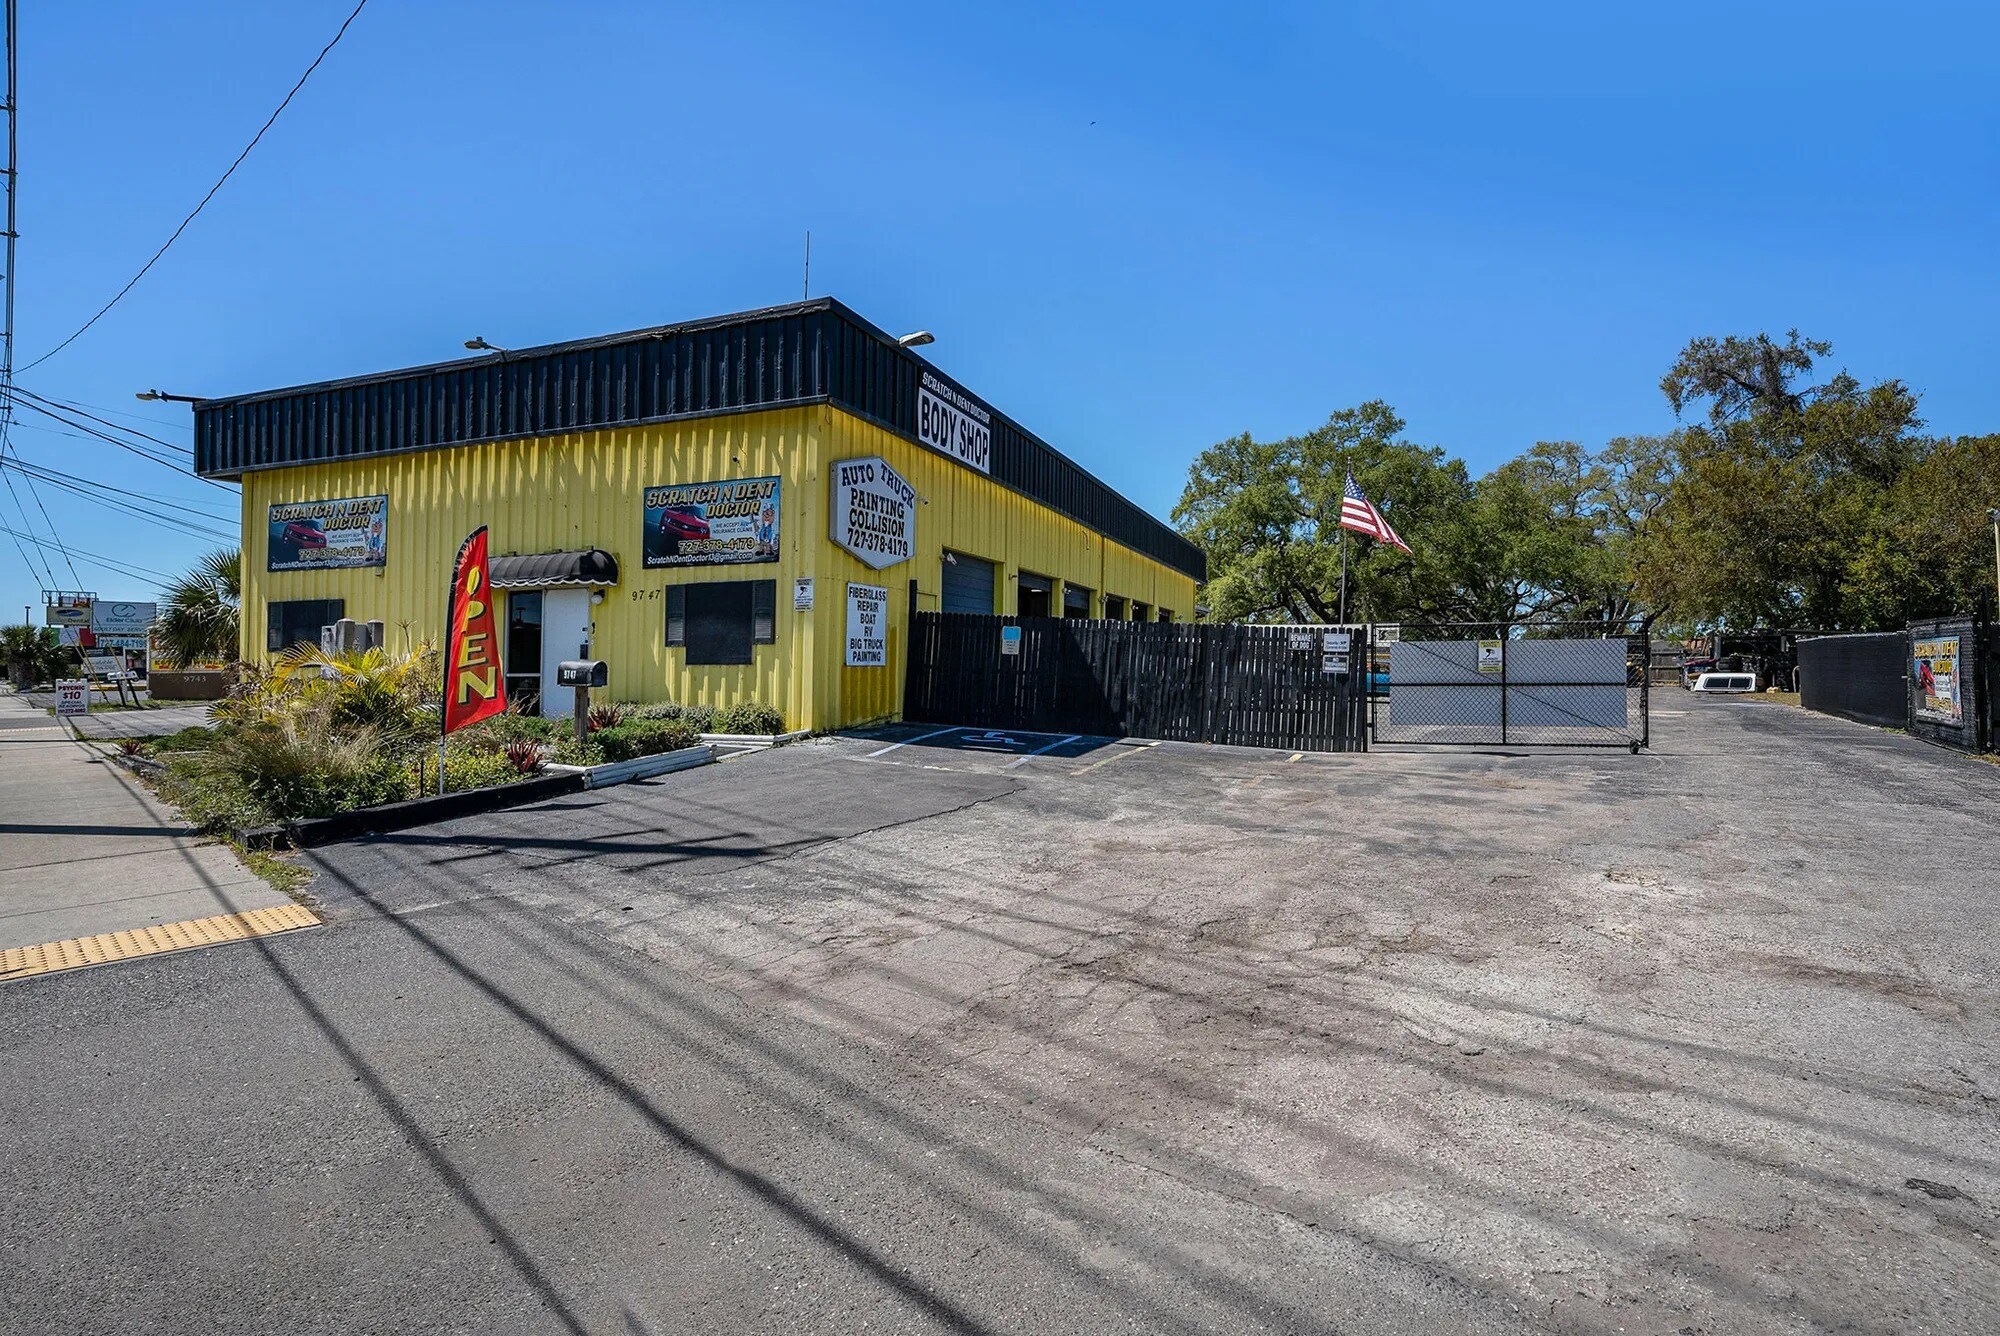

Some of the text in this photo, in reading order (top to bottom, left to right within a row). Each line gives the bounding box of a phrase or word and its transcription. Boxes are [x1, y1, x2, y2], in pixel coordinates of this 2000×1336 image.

[922, 372, 990, 424] SCRATCH N DENT DOCTOR
[921, 394, 989, 468] BODY SHOP
[841, 463, 914, 509] AUTO TRUCK
[646, 481, 777, 508] SCRATCH N DENT
[271, 499, 384, 522] SCRATCH N DENT
[706, 501, 763, 519] DOCTOR
[850, 487, 905, 520] PAINTING
[322, 515, 371, 531] DOCTOR
[849, 508, 905, 539] COLLISION
[678, 538, 756, 555] 727-378-4179
[848, 527, 909, 558] 727-378-4179
[298, 546, 366, 560] 727-378-4179
[849, 587, 886, 602] FIBERGLASS
[857, 600, 879, 612] REPAIR
[860, 613, 876, 625] BOAT
[458, 566, 497, 704] OPEN
[864, 626, 874, 637] RV
[1290, 634, 1312, 642] BEWARE
[850, 638, 884, 651] BIG TRUCK
[1291, 641, 1310, 649] OF DOG
[852, 651, 881, 662] PAINTING
[183, 675, 207, 683] 9743
[564, 670, 577, 679] 9747
[63, 691, 81, 700] $10
